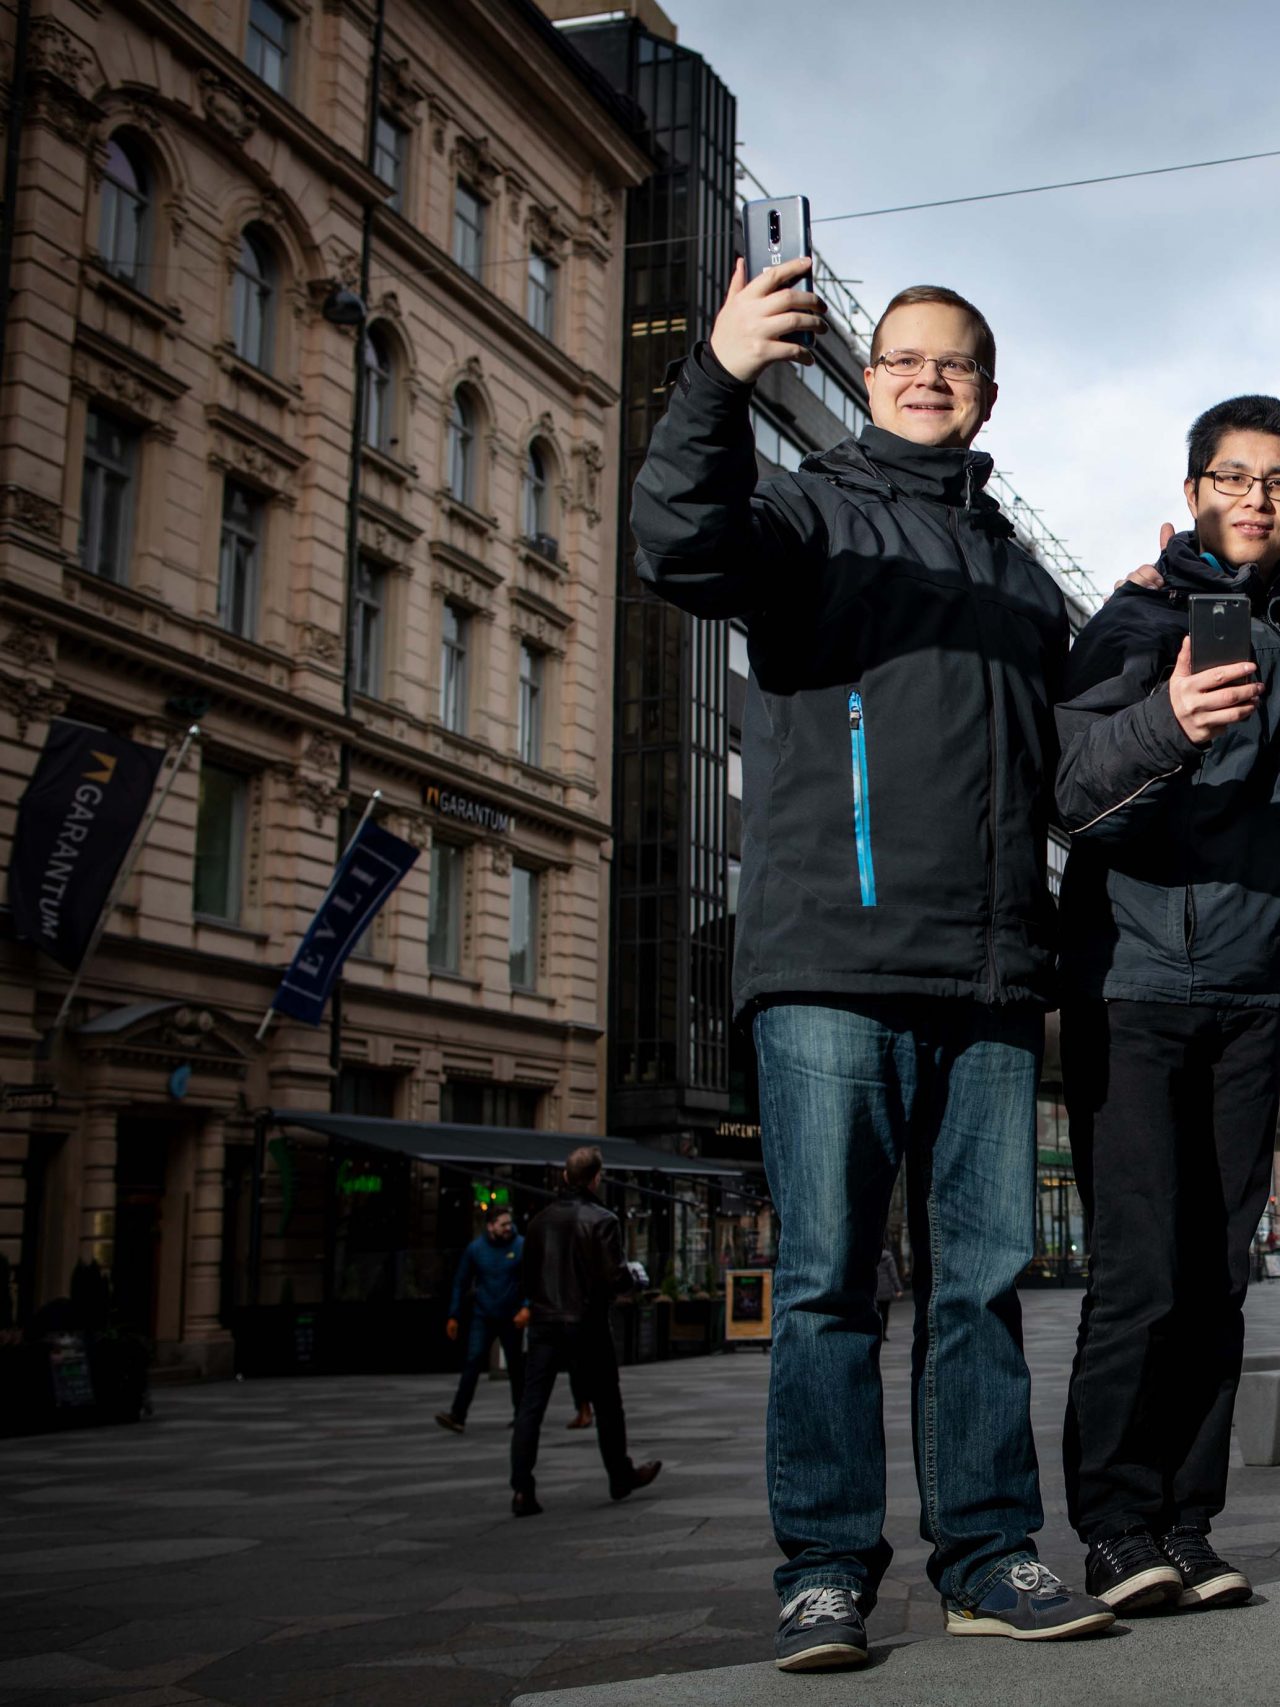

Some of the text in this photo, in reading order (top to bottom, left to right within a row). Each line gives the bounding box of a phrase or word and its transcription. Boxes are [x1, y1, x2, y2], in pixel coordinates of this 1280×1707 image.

[39, 784, 103, 940] GARANTUM
[440, 792, 509, 832] GARANTUM
[296, 864, 379, 978] EVLI
